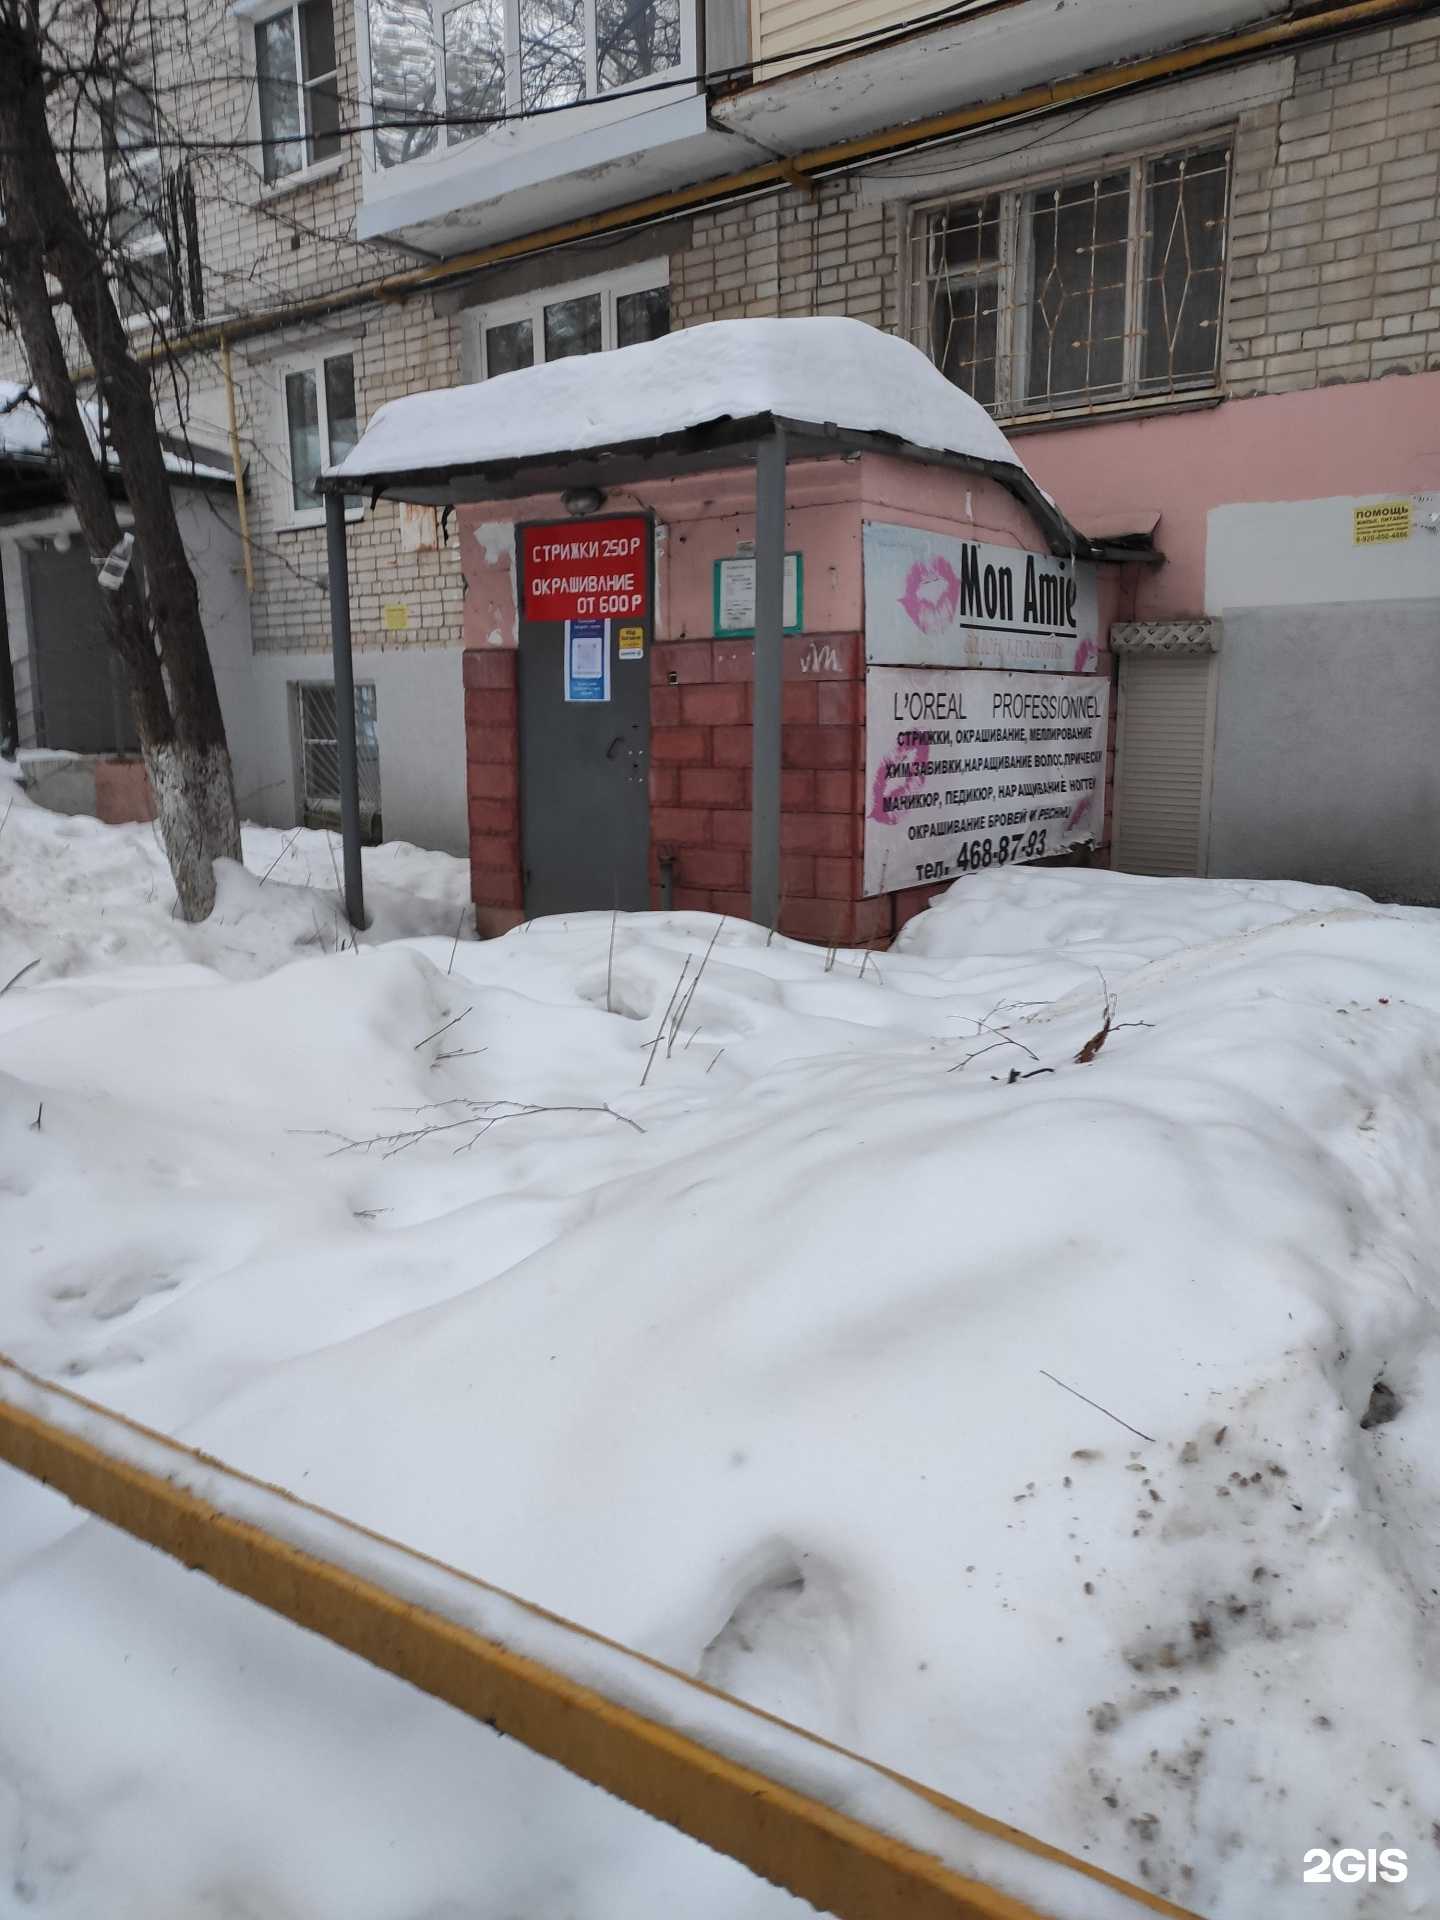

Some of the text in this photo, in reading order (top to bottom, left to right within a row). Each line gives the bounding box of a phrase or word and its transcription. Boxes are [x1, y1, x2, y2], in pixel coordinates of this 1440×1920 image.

[1356, 506, 1408, 519] ПОМОЩЬ
[533, 538, 640, 563] СТРИЖКИ 250 Р
[532, 573, 634, 596] ОКРАШИВАНИЕ
[960, 543, 1076, 628] Mon Amie
[577, 594, 641, 614] ОТ 600 Р
[894, 692, 1101, 720] L'OREAL PROFESSIONNEL
[897, 731, 953, 747] СТРИЖКИ,
[956, 728, 1027, 744] ОКРАШИВАНИЕ,
[882, 792, 942, 812] МАНИКЮР,
[908, 816, 986, 840] ОКРАШИВАНИЕ
[988, 809, 1027, 828] БРОВЕЙ
[915, 829, 1047, 881] тел. 468-87-93
